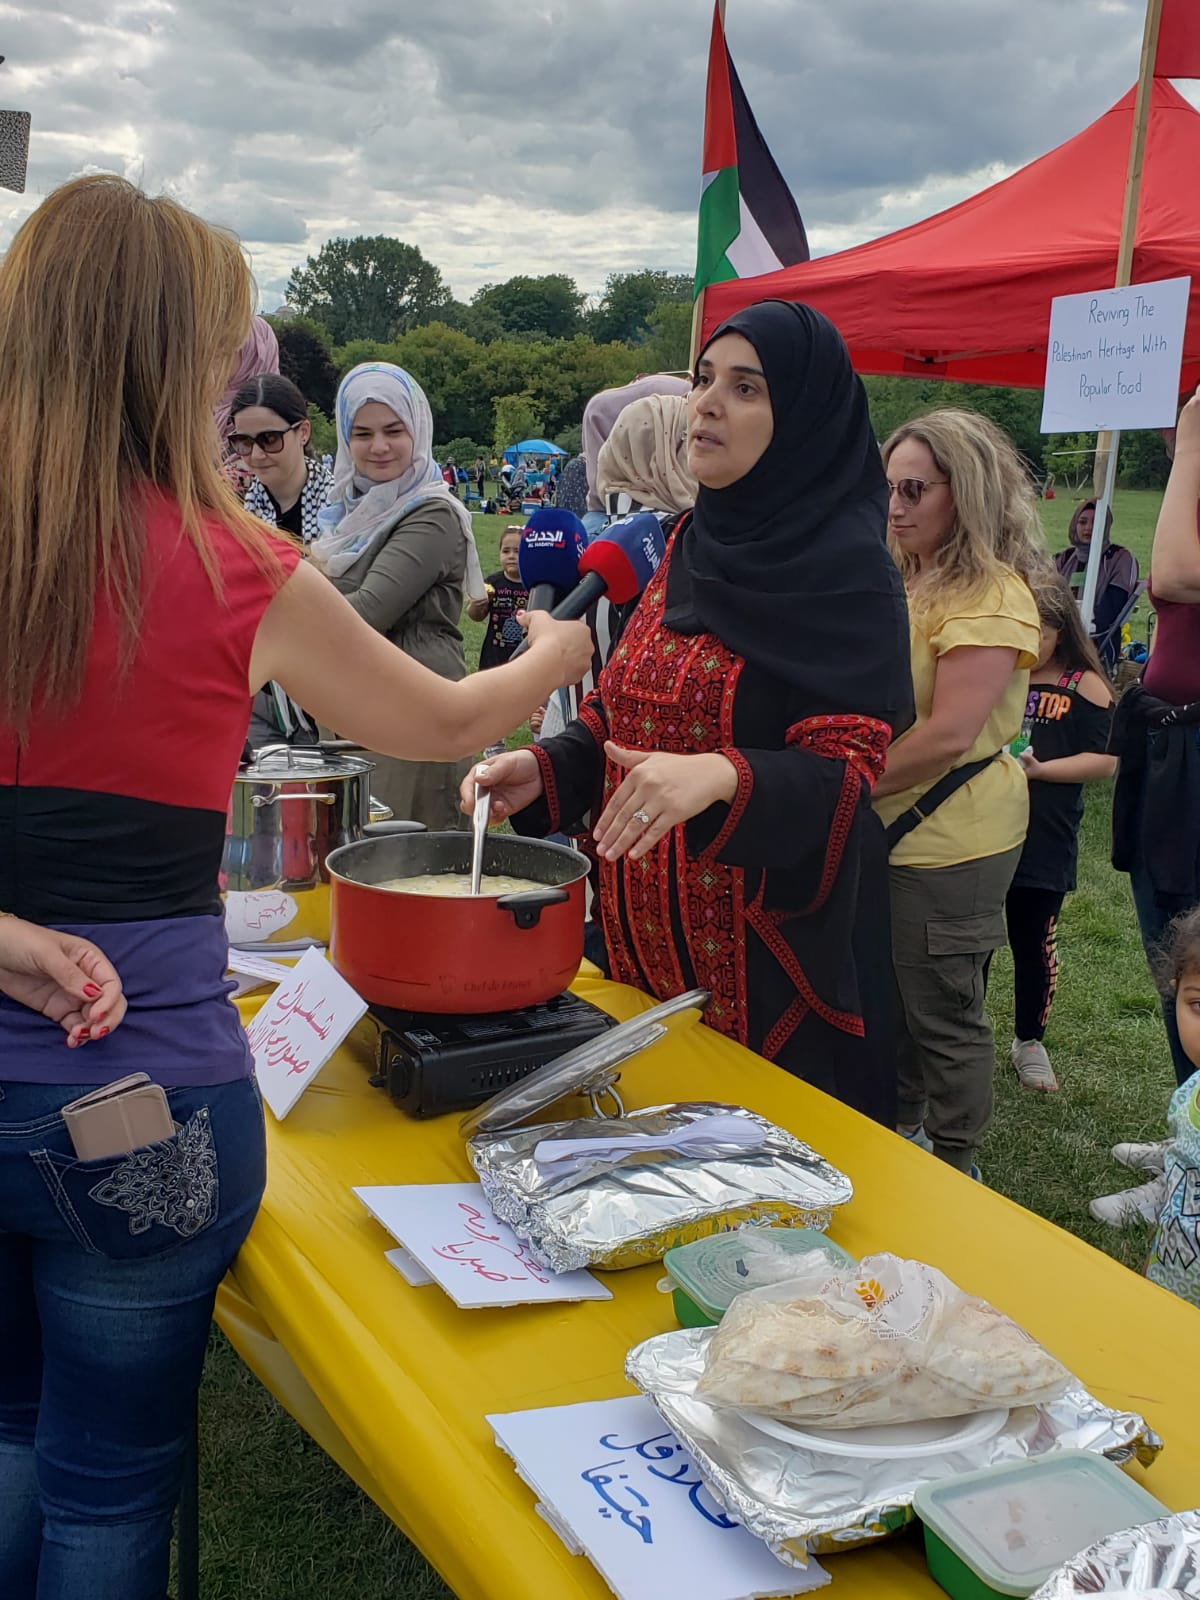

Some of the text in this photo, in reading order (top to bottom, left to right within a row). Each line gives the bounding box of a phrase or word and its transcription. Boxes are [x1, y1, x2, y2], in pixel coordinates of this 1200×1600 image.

[1089, 296, 1154, 326] Reviving The
[1099, 338, 1135, 359] Heritage
[1142, 334, 1167, 354] With
[1080, 371, 1142, 402] Popular Food
[525, 530, 563, 543] الحدث
[498, 588, 512, 596] win
